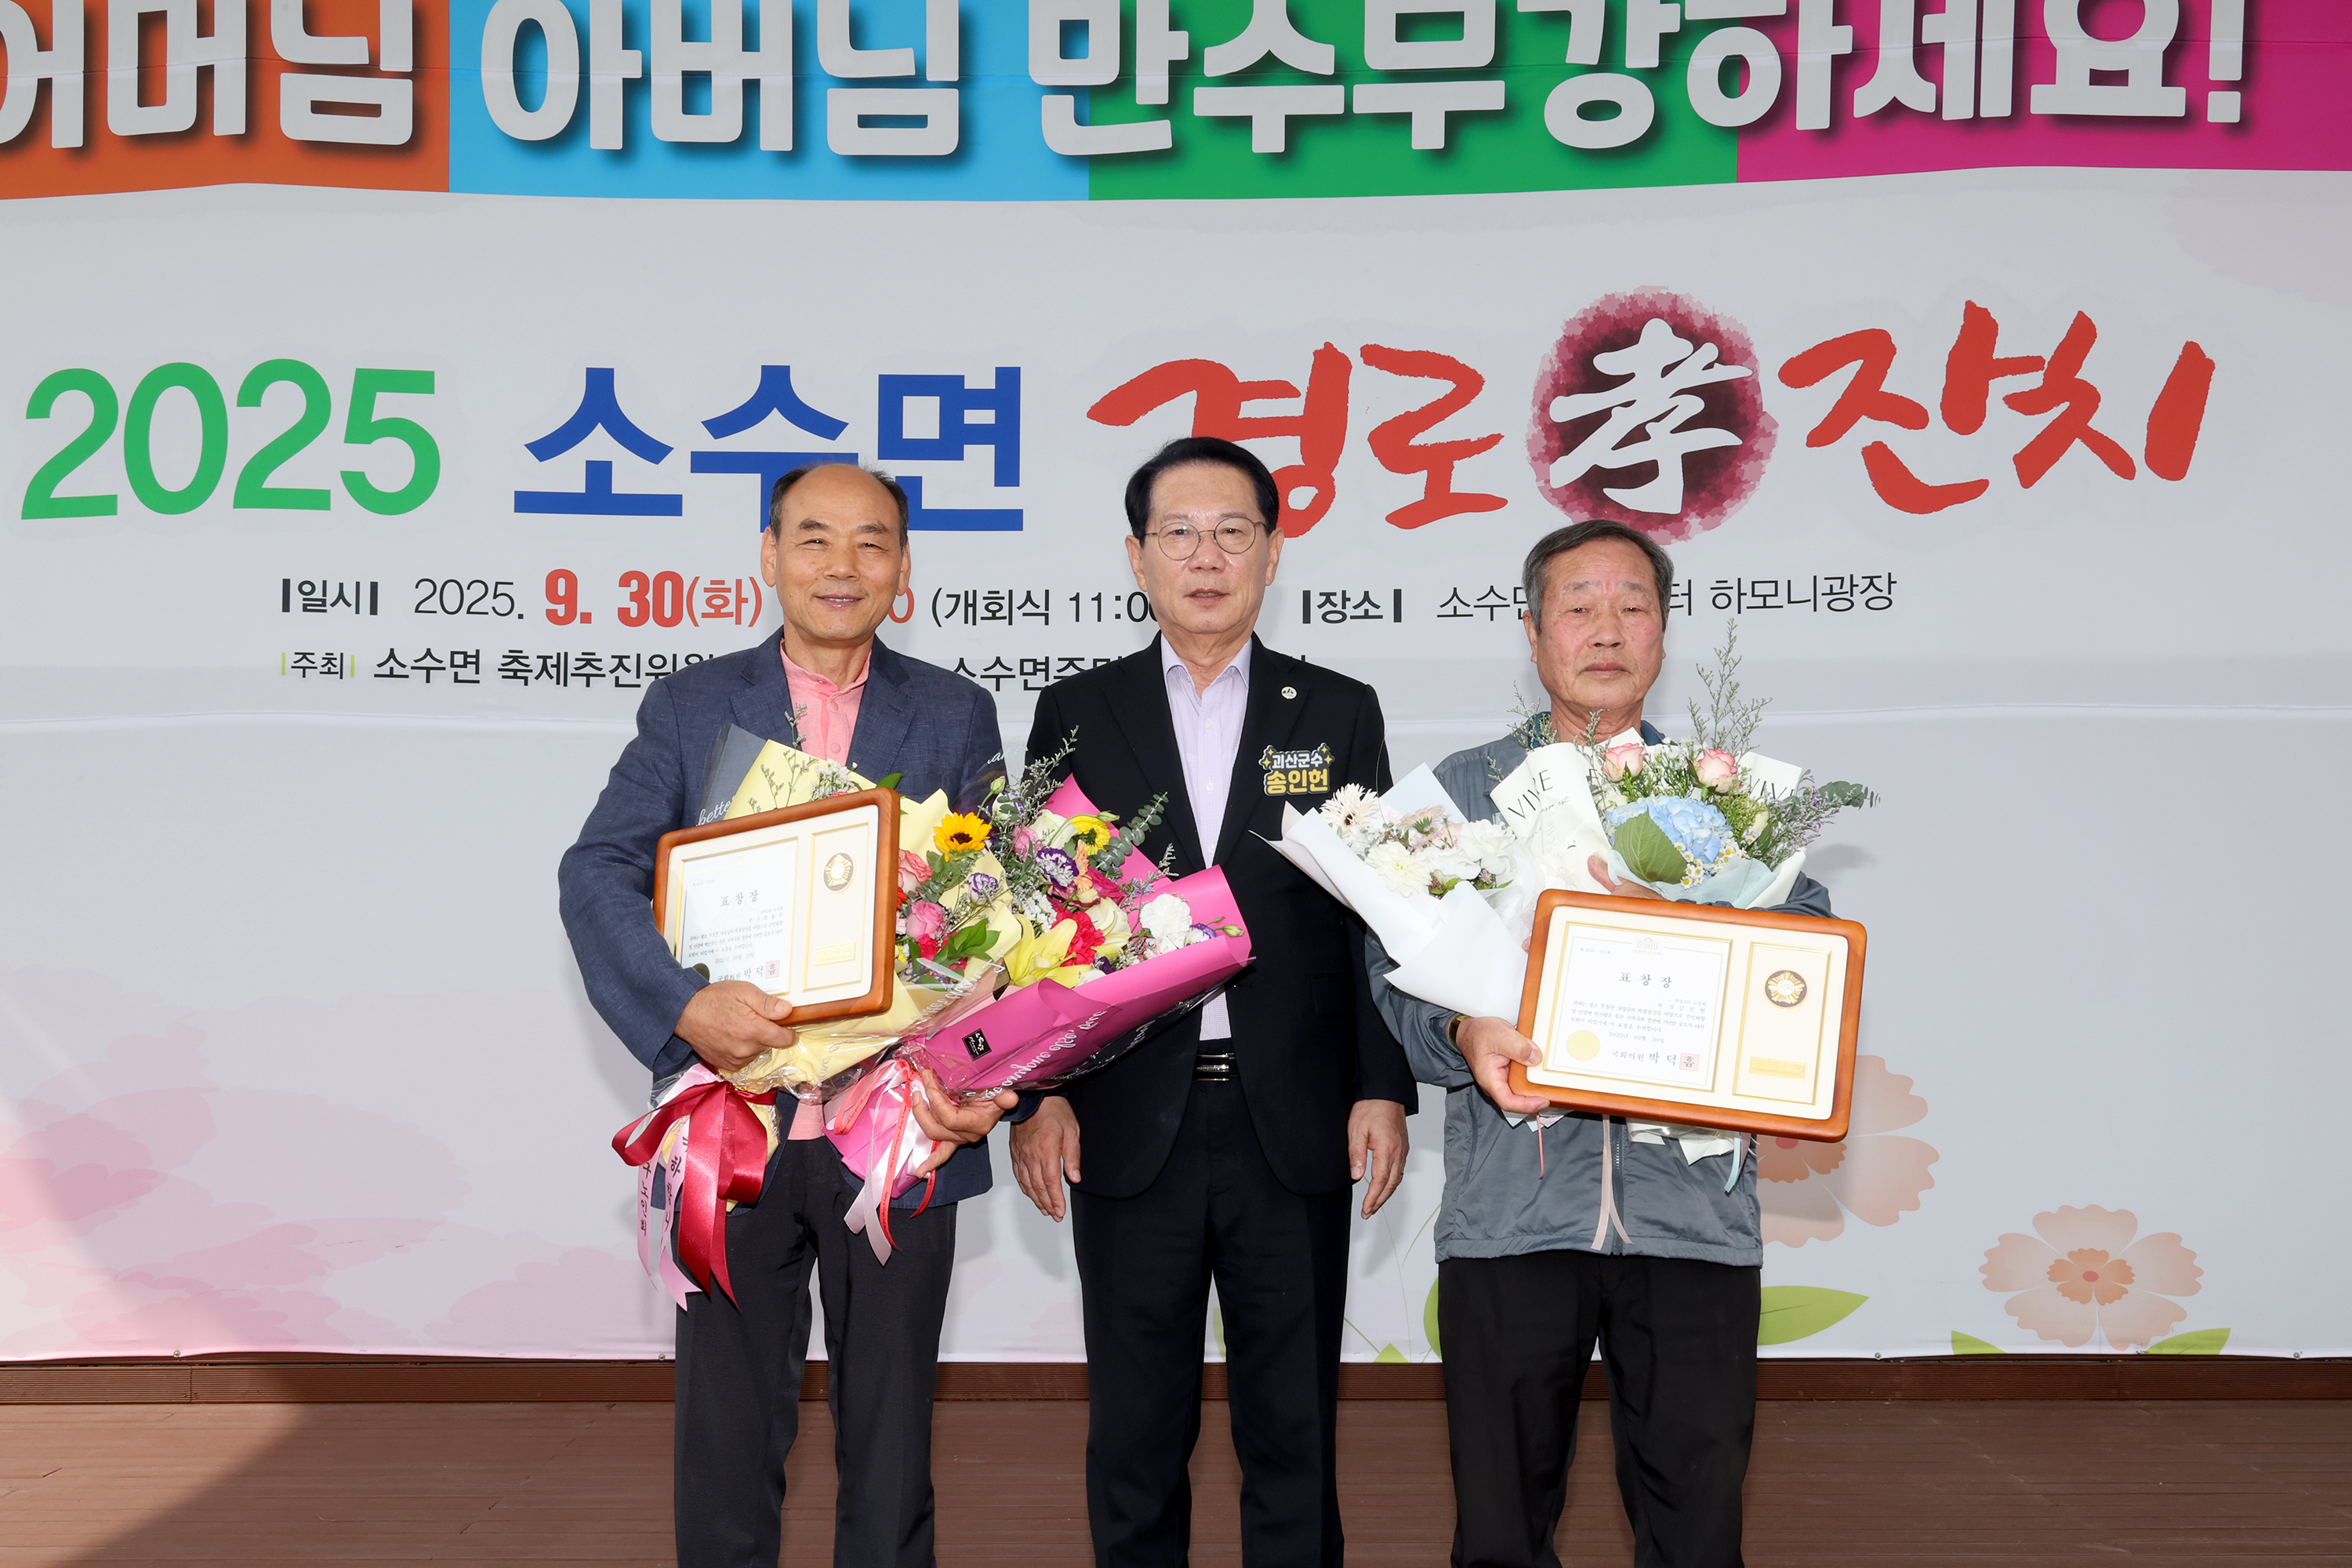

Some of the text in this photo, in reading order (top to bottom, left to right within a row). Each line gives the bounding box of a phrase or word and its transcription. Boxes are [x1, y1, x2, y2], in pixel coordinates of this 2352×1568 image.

[481, 0, 959, 156] 아버님
[1029, 0, 2242, 156] 만수무강하세요!
[21, 300, 2216, 539] 2025 소수면 경로 孝 잔치
[415, 579, 524, 620] 2025.
[617, 570, 764, 628] 30(화)
[931, 587, 1050, 627] (개회식
[1069, 591, 1158, 622] 11:0
[1710, 572, 1898, 615] 하모니광장
[373, 648, 481, 686] 소수면
[1272, 752, 1323, 769] 괴산군수
[1266, 768, 1329, 794] 송인헌
[720, 889, 758, 906] 표창장
[1617, 971, 1672, 989] 표창장
[1610, 1049, 1644, 1062] 국회의원
